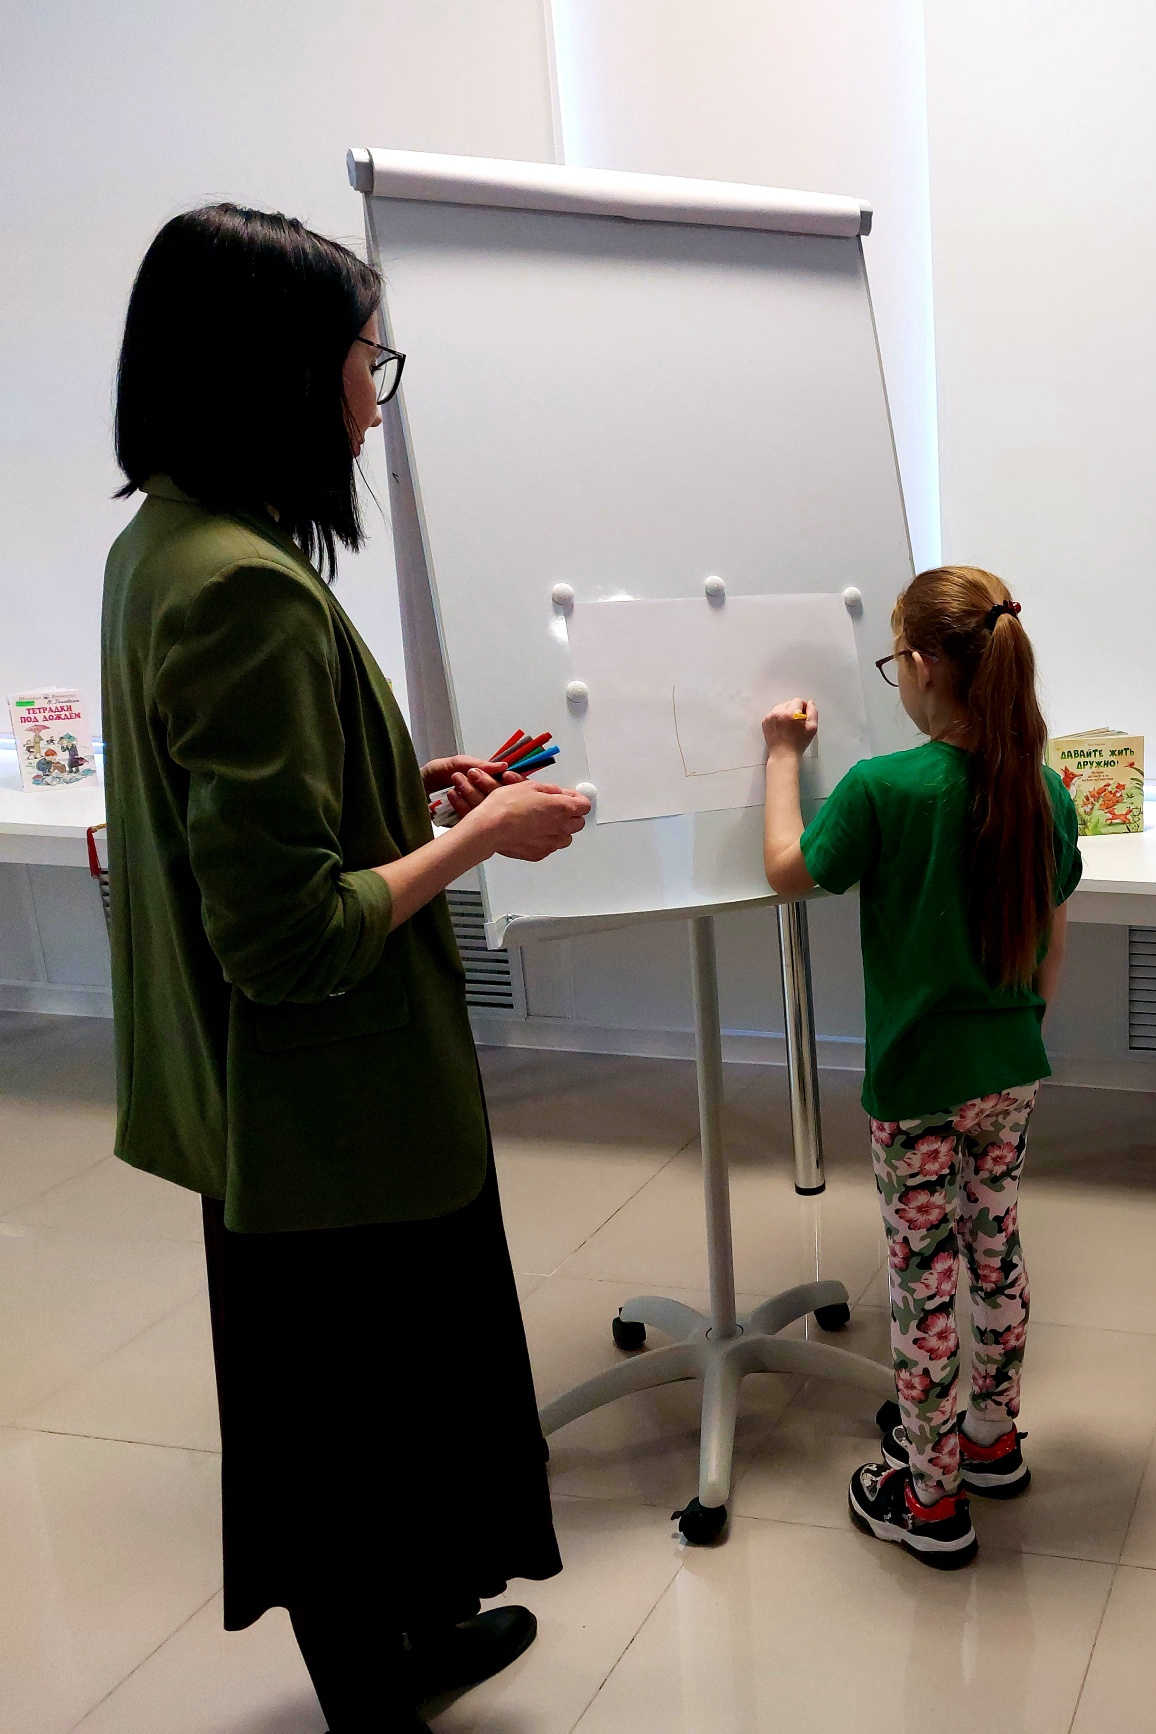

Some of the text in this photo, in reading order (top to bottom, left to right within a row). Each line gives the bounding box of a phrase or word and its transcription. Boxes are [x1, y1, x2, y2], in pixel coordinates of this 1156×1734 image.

[26, 705, 73, 715] ТЕТРАДКИ
[20, 716, 39, 724] ПОД
[1060, 747, 1135, 760] ДАВАЙТЕ ЖИТЬ
[1076, 759, 1119, 770] ДРУЖНО!
